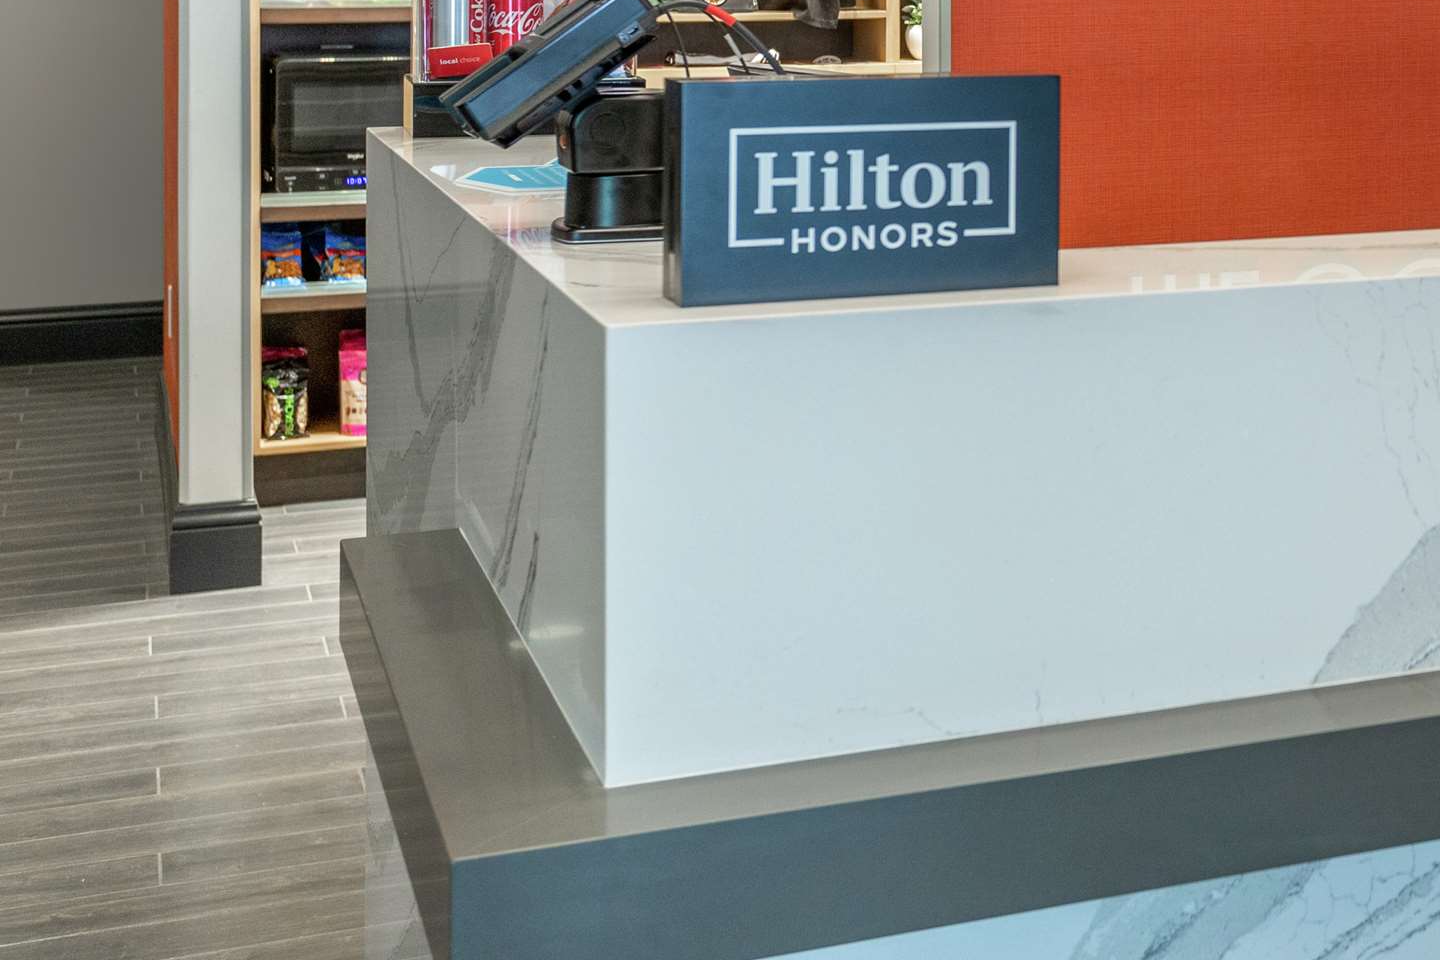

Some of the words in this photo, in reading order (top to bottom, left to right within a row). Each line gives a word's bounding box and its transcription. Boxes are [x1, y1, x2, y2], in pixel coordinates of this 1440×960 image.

[439, 57, 459, 65] local
[753, 149, 994, 215] Hilton
[791, 220, 959, 254] HONORS
